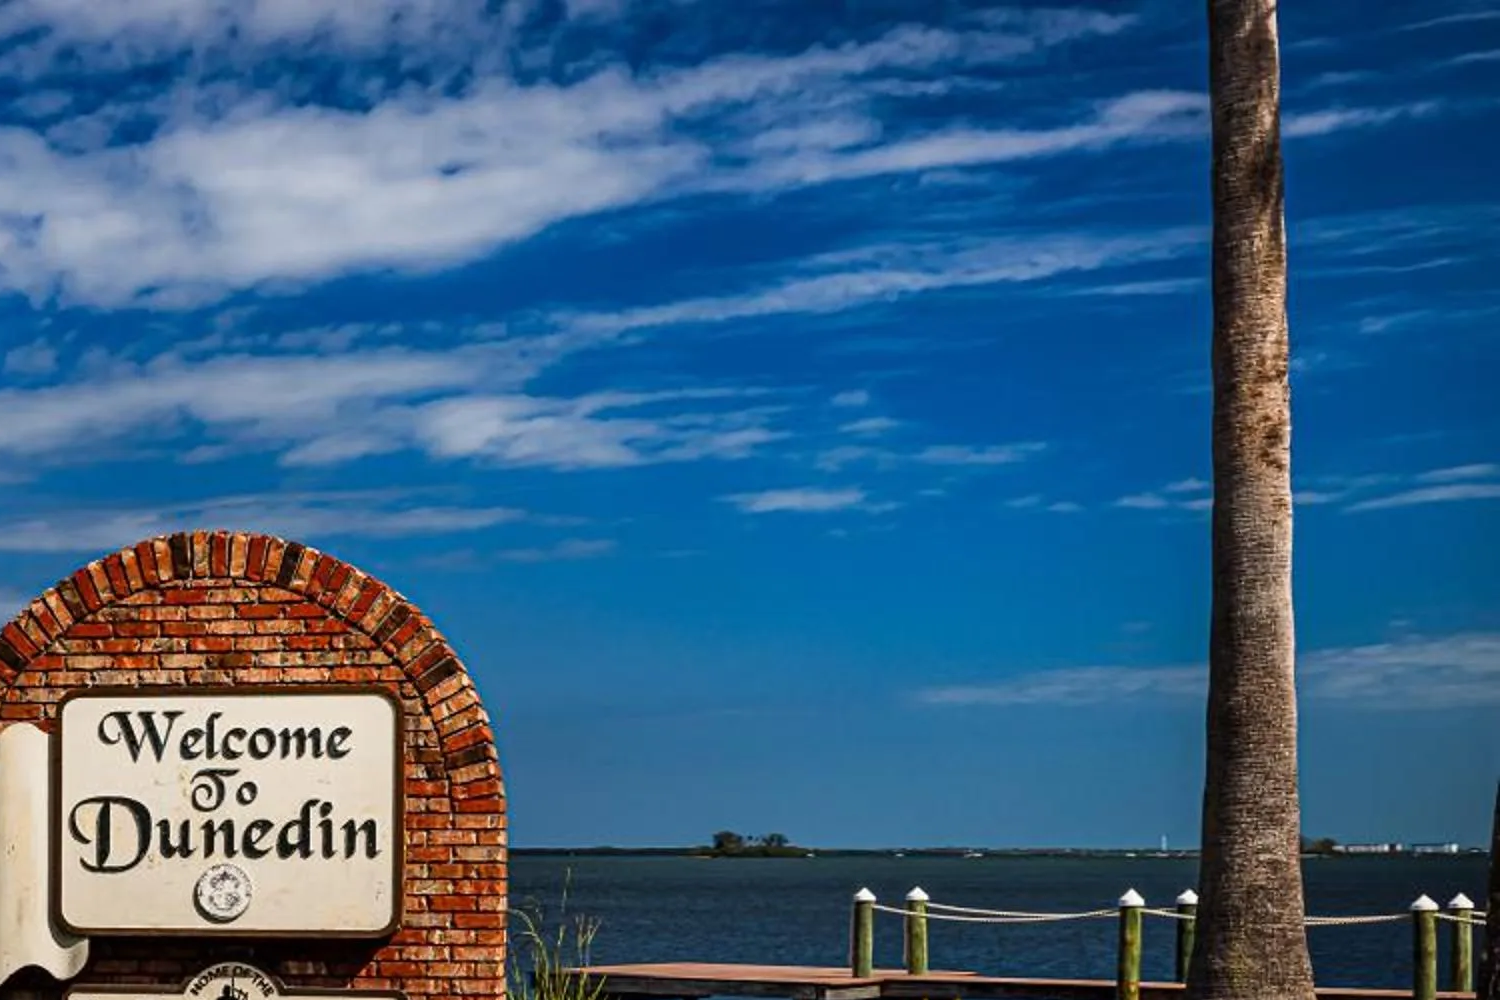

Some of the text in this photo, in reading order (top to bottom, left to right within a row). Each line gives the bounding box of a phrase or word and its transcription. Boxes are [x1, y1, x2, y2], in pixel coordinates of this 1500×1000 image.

[97, 710, 353, 763] Welcome
[189, 767, 259, 812] To
[68, 795, 383, 874] Dunedin
[189, 965, 275, 998] HOME OF THE
